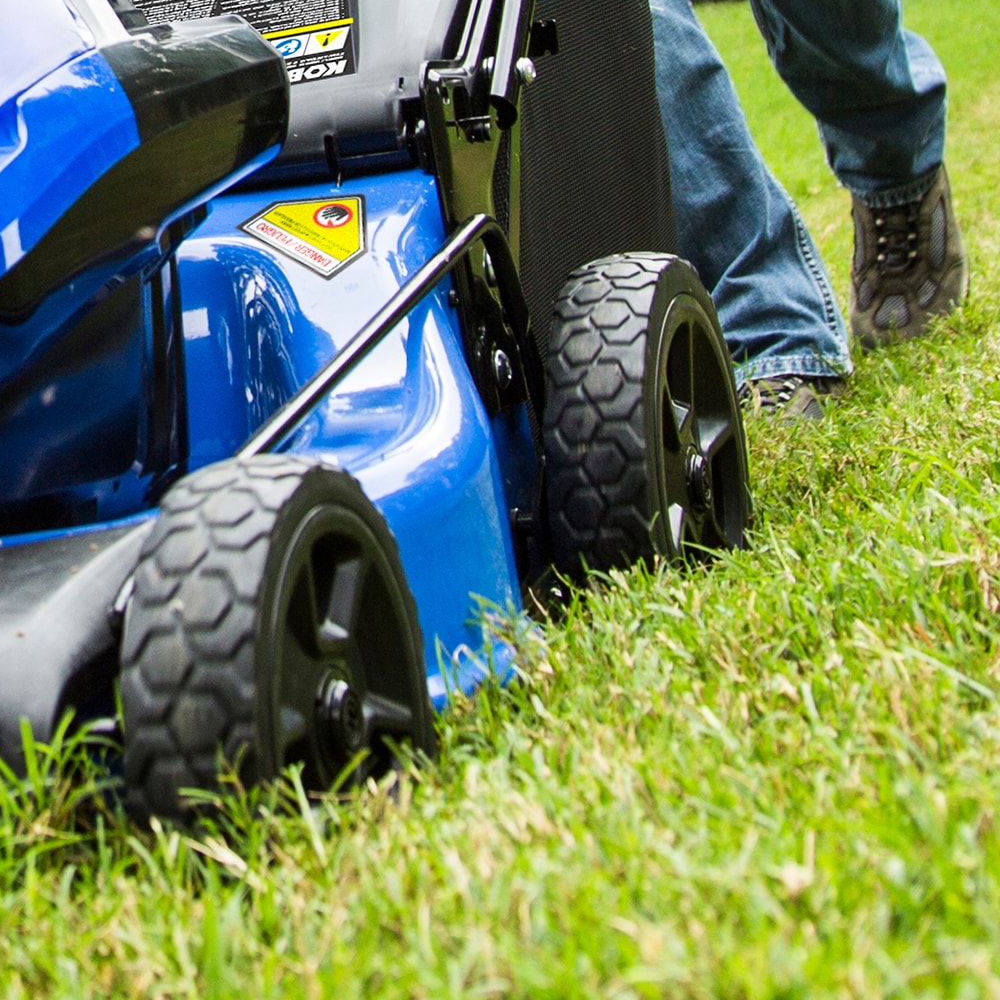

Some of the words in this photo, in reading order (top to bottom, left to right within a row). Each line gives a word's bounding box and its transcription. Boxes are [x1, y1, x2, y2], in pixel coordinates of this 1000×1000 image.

[287, 59, 348, 83] KOB
[256, 223, 293, 245] PELIGRO
[294, 244, 332, 267] DANGER
